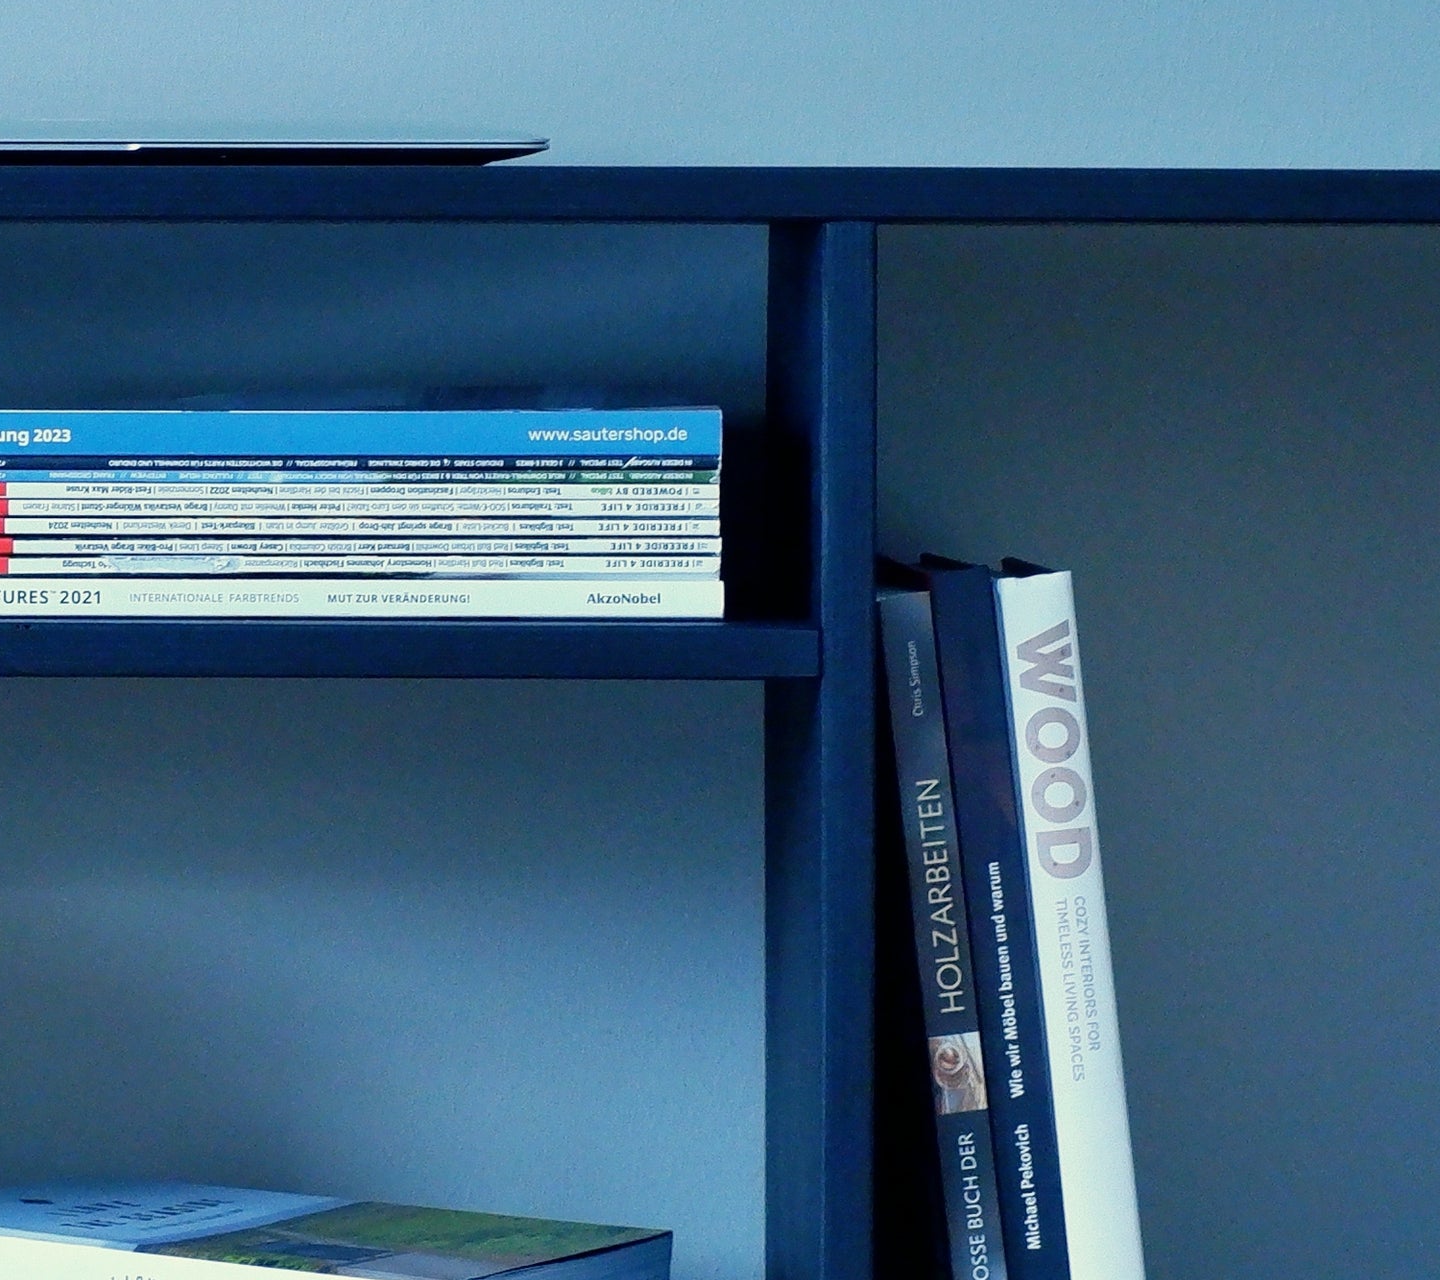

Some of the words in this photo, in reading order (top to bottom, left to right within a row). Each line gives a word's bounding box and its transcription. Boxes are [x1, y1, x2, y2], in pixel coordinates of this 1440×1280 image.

[33, 428, 71, 443] 2023
[528, 427, 688, 444] www.sautershop.de
[59, 589, 102, 605] 2021
[128, 593, 223, 604] INTERNATIONALE
[228, 593, 300, 604] FARBTRENDS
[327, 593, 353, 604] MUT
[356, 593, 378, 604] ZUR
[381, 591, 471, 604] VERÄNDERUNG!
[586, 592, 662, 605] AkzoNobel
[906, 640, 924, 687] Simpson
[911, 688, 925, 718] Chris
[1016, 619, 1093, 880] WOOD
[915, 778, 966, 1014] HOLZARBEITEN
[987, 861, 1005, 912] warum
[990, 914, 1009, 943] und
[1055, 897, 1075, 970] TIMELESS
[1072, 895, 1091, 936] COZY
[995, 945, 1014, 991] bauen
[1078, 938, 1098, 1019] INTERIORS
[999, 993, 1019, 1041] Möbel
[1061, 972, 1080, 1023] LIVING
[1005, 1042, 1022, 1067] wir
[1068, 1025, 1087, 1083] SPACES
[1087, 1021, 1101, 1052] FOR
[1008, 1069, 1026, 1099] Wie
[957, 1131, 977, 1170] DER
[1013, 1123, 1036, 1190] Pekovich
[962, 1175, 985, 1230] BUCH
[1019, 1191, 1042, 1249] Michael
